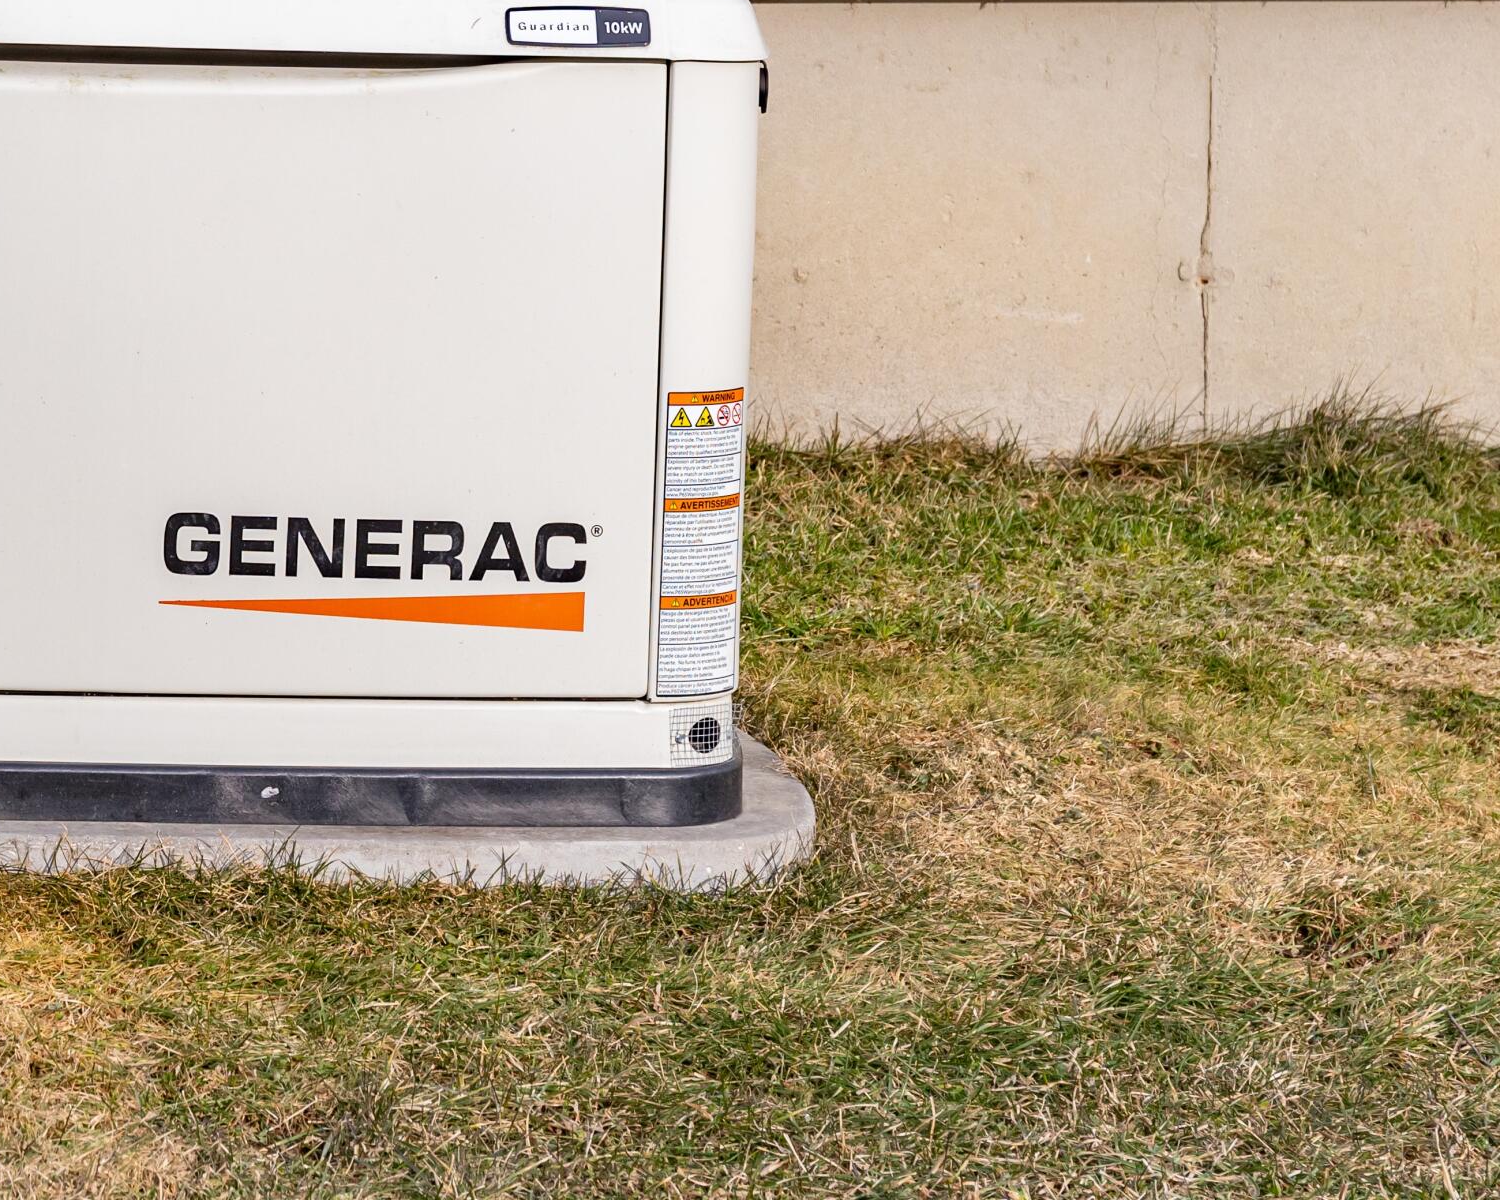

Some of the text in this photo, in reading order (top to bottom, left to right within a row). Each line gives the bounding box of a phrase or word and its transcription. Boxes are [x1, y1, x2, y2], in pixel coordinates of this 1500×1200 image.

[518, 21, 643, 34] Guardian 10kW
[702, 392, 735, 403] WARNING
[680, 496, 739, 509] AVERTISSEMENT
[683, 594, 733, 607] ADVERTENCIA
